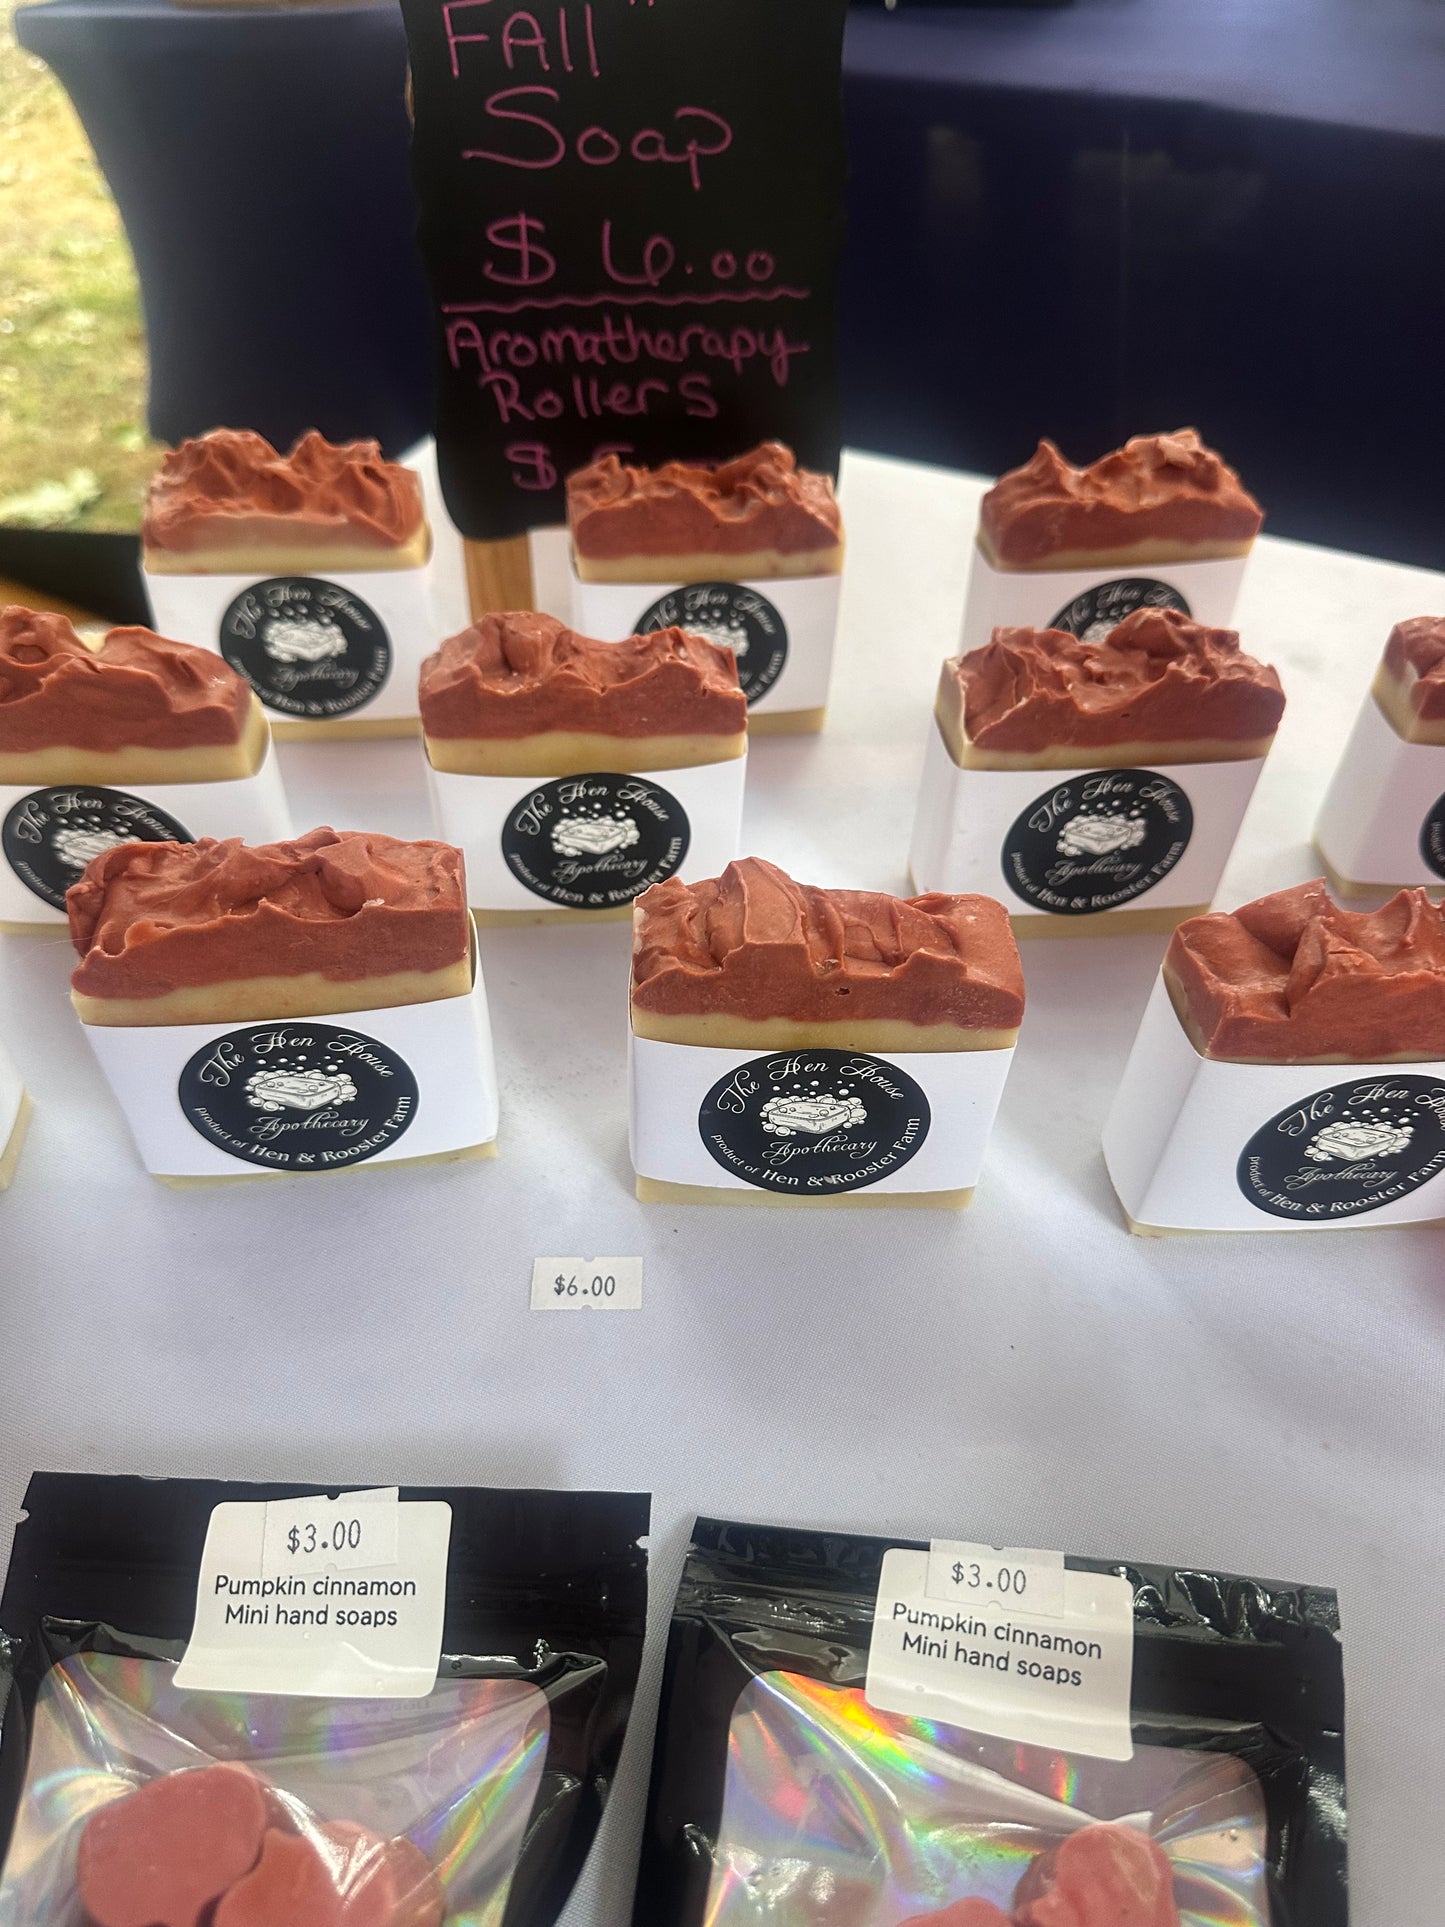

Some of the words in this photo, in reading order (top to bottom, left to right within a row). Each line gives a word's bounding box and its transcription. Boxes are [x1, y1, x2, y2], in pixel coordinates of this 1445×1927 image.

[462, 85, 733, 191] Soap
[445, 313, 811, 386] Aromatherapy
[51, 791, 105, 814] Hen
[515, 792, 553, 836] The
[557, 778, 609, 804] Hen
[616, 782, 670, 822] House
[1028, 787, 1072, 832] The
[1081, 773, 1134, 800] Hen
[551, 885, 584, 903] Hen
[608, 868, 664, 901] Rooster
[659, 836, 683, 868] Farm
[552, 853, 649, 885] Apothecary
[200, 1041, 246, 1087] The
[251, 1028, 317, 1054] Hen
[327, 1034, 395, 1078] House
[716, 1069, 760, 1115] The
[766, 1053, 830, 1081] Hen
[839, 1057, 905, 1101] House
[194, 1106, 232, 1140] product
[231, 1137, 250, 1149] of
[251, 1143, 290, 1163] Hen
[298, 1152, 316, 1164] &
[321, 1130, 391, 1163] Rooster
[387, 1095, 412, 1129] Farm
[250, 1111, 369, 1141] Apothecary
[1277, 1092, 1335, 1137] The
[1348, 1080, 1411, 1105] Hen
[710, 1133, 745, 1167] product
[744, 1164, 762, 1175] of
[762, 1169, 799, 1186] Hen
[806, 1176, 825, 1187] &
[830, 1151, 898, 1185] Rooster
[893, 1117, 921, 1151] Farm
[761, 1134, 878, 1166] Apothecary
[1284, 1162, 1399, 1190] Apothecary
[1269, 1192, 1302, 1212] Hen
[1306, 1202, 1325, 1214] &
[1330, 1181, 1406, 1213] Rooster
[553, 1273, 616, 1297] $6.00
[287, 1519, 361, 1555] $3.00
[214, 1574, 306, 1598] Pumpkin
[312, 1576, 417, 1597] cinnamon
[950, 1561, 1027, 1595] $3.00
[224, 1603, 269, 1625] Mini
[275, 1604, 329, 1626] hand
[335, 1609, 398, 1628] soaps
[892, 1602, 987, 1637] Pumpkin
[994, 1622, 1102, 1660] cinnamon
[902, 1631, 948, 1659] Mini
[954, 1640, 1010, 1672] hand
[1016, 1659, 1083, 1688] soaps
